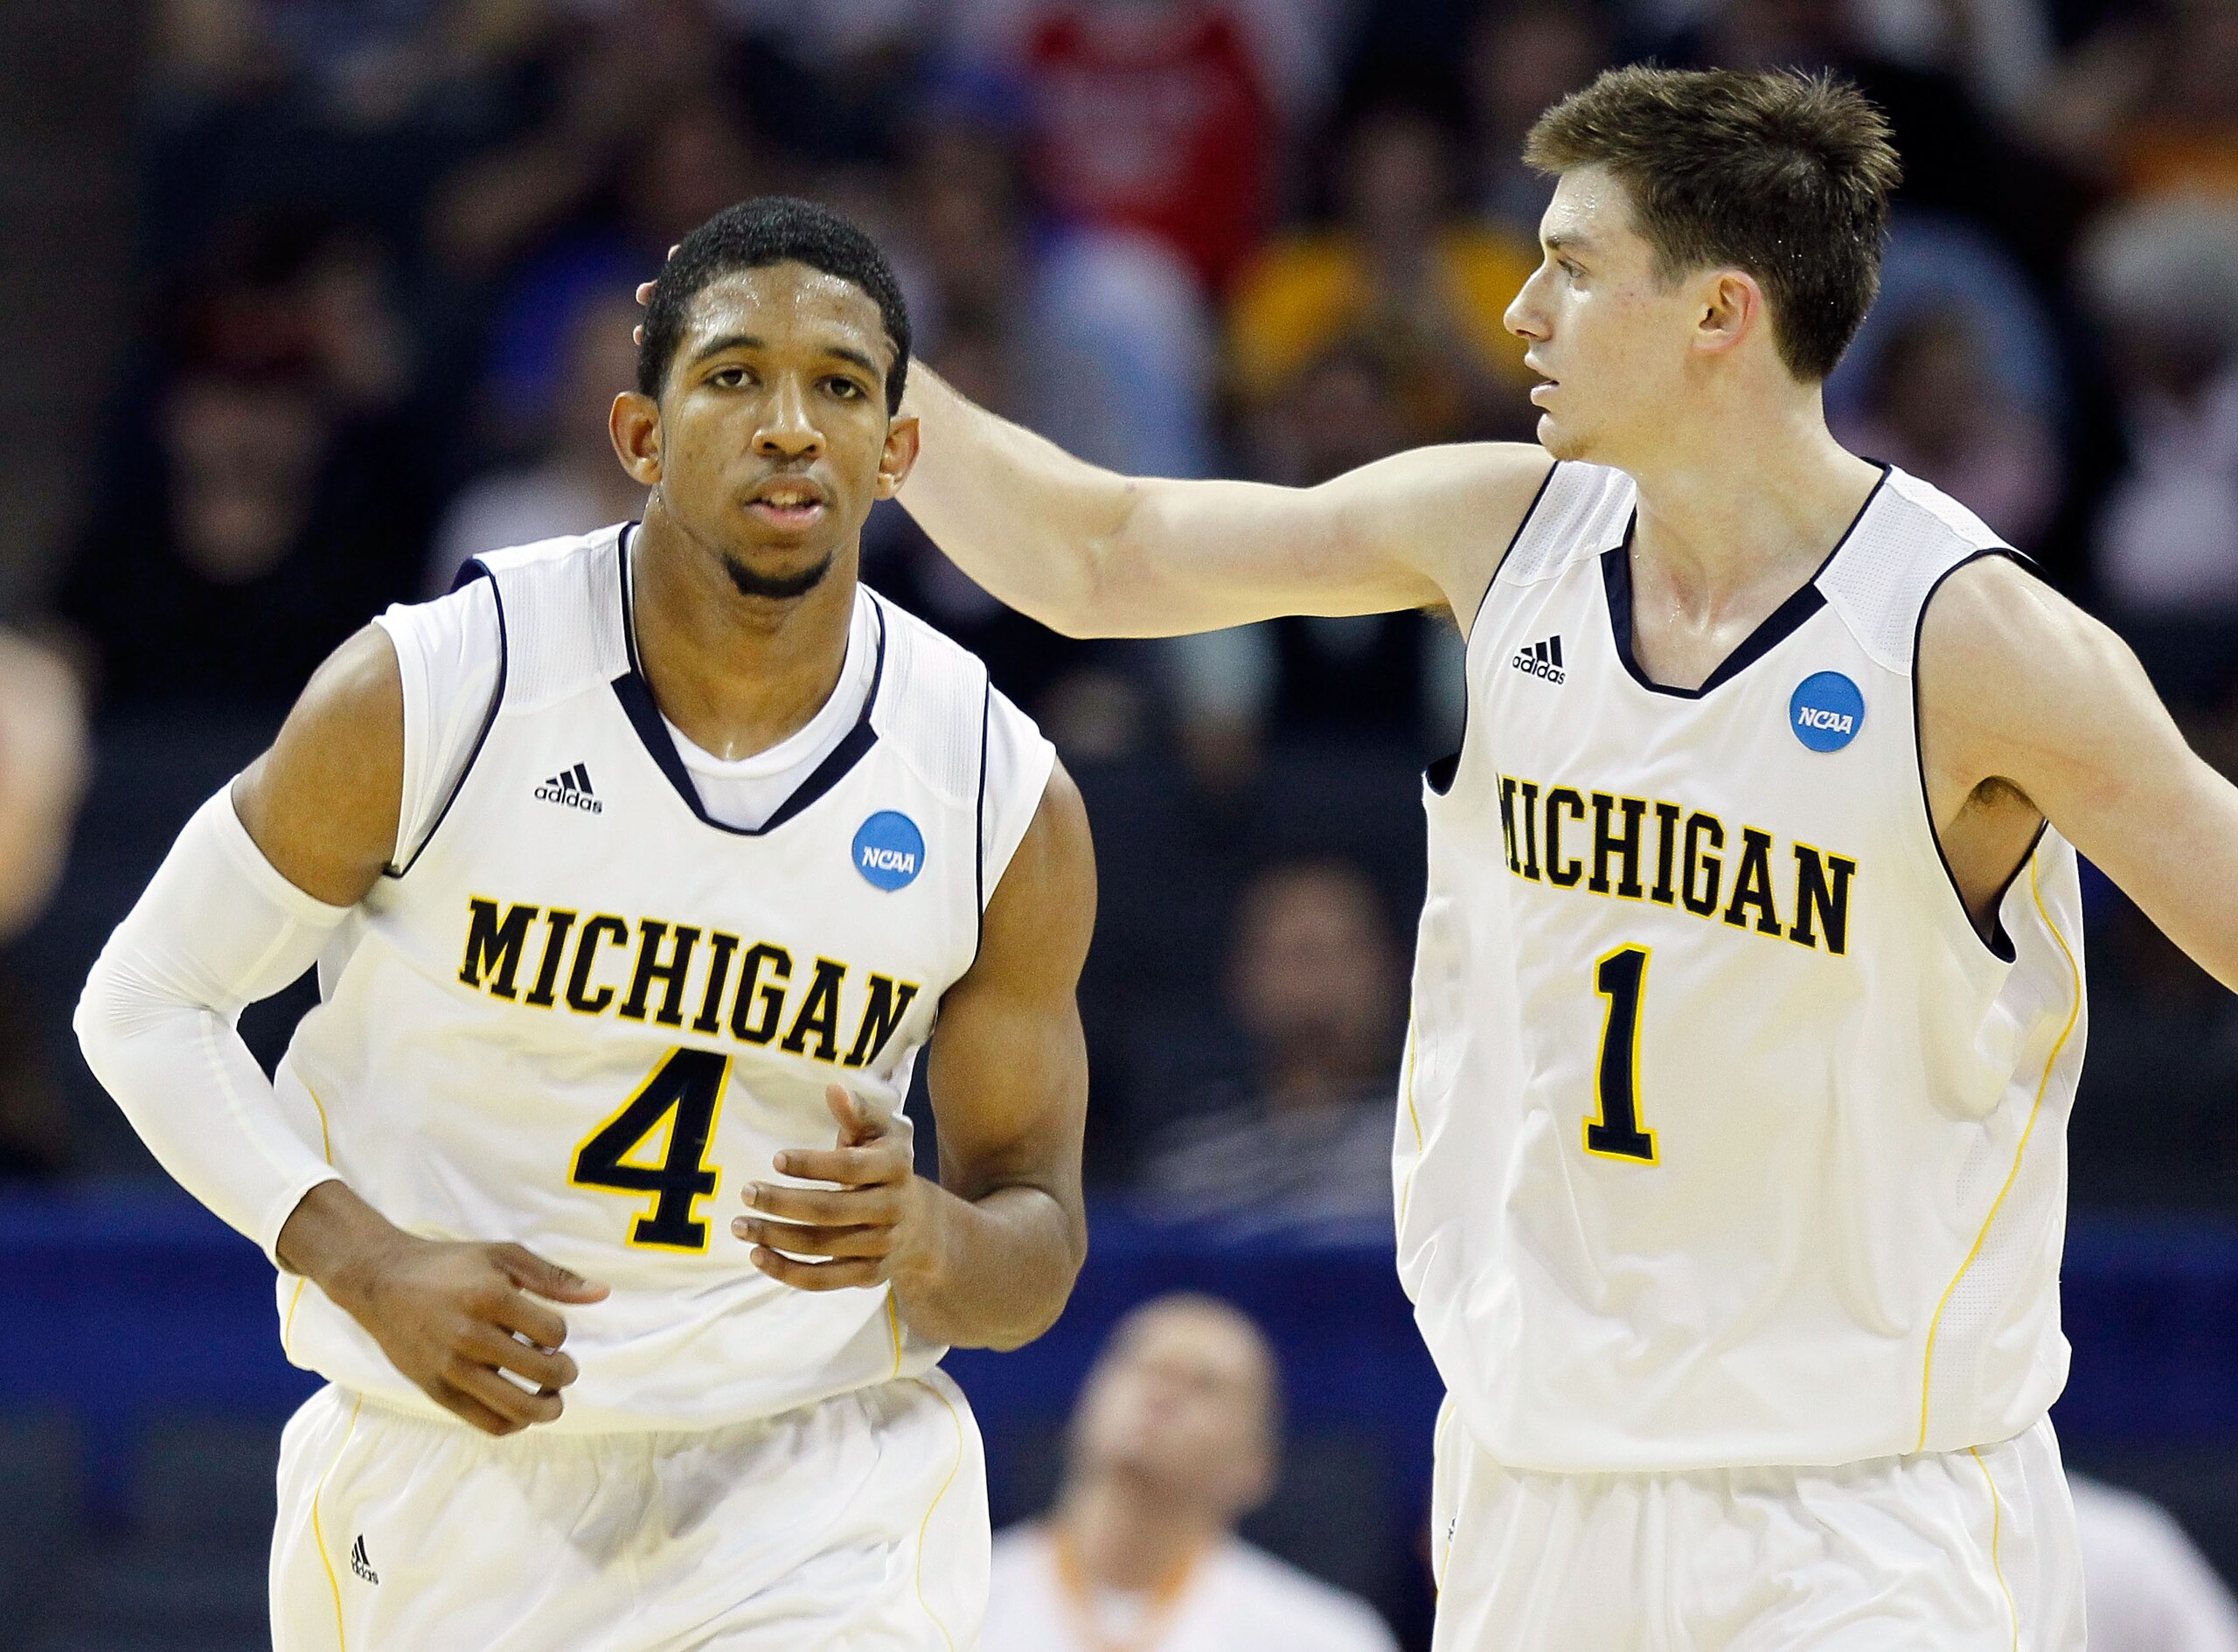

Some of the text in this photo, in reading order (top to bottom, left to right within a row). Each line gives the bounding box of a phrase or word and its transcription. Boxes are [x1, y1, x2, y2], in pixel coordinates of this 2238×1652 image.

[1512, 656, 1566, 685] adidas
[1798, 706, 1853, 735] NCAA
[861, 845, 916, 875] NCAA
[1582, 942, 1660, 1167] 1
[566, 1045, 733, 1255] 4
